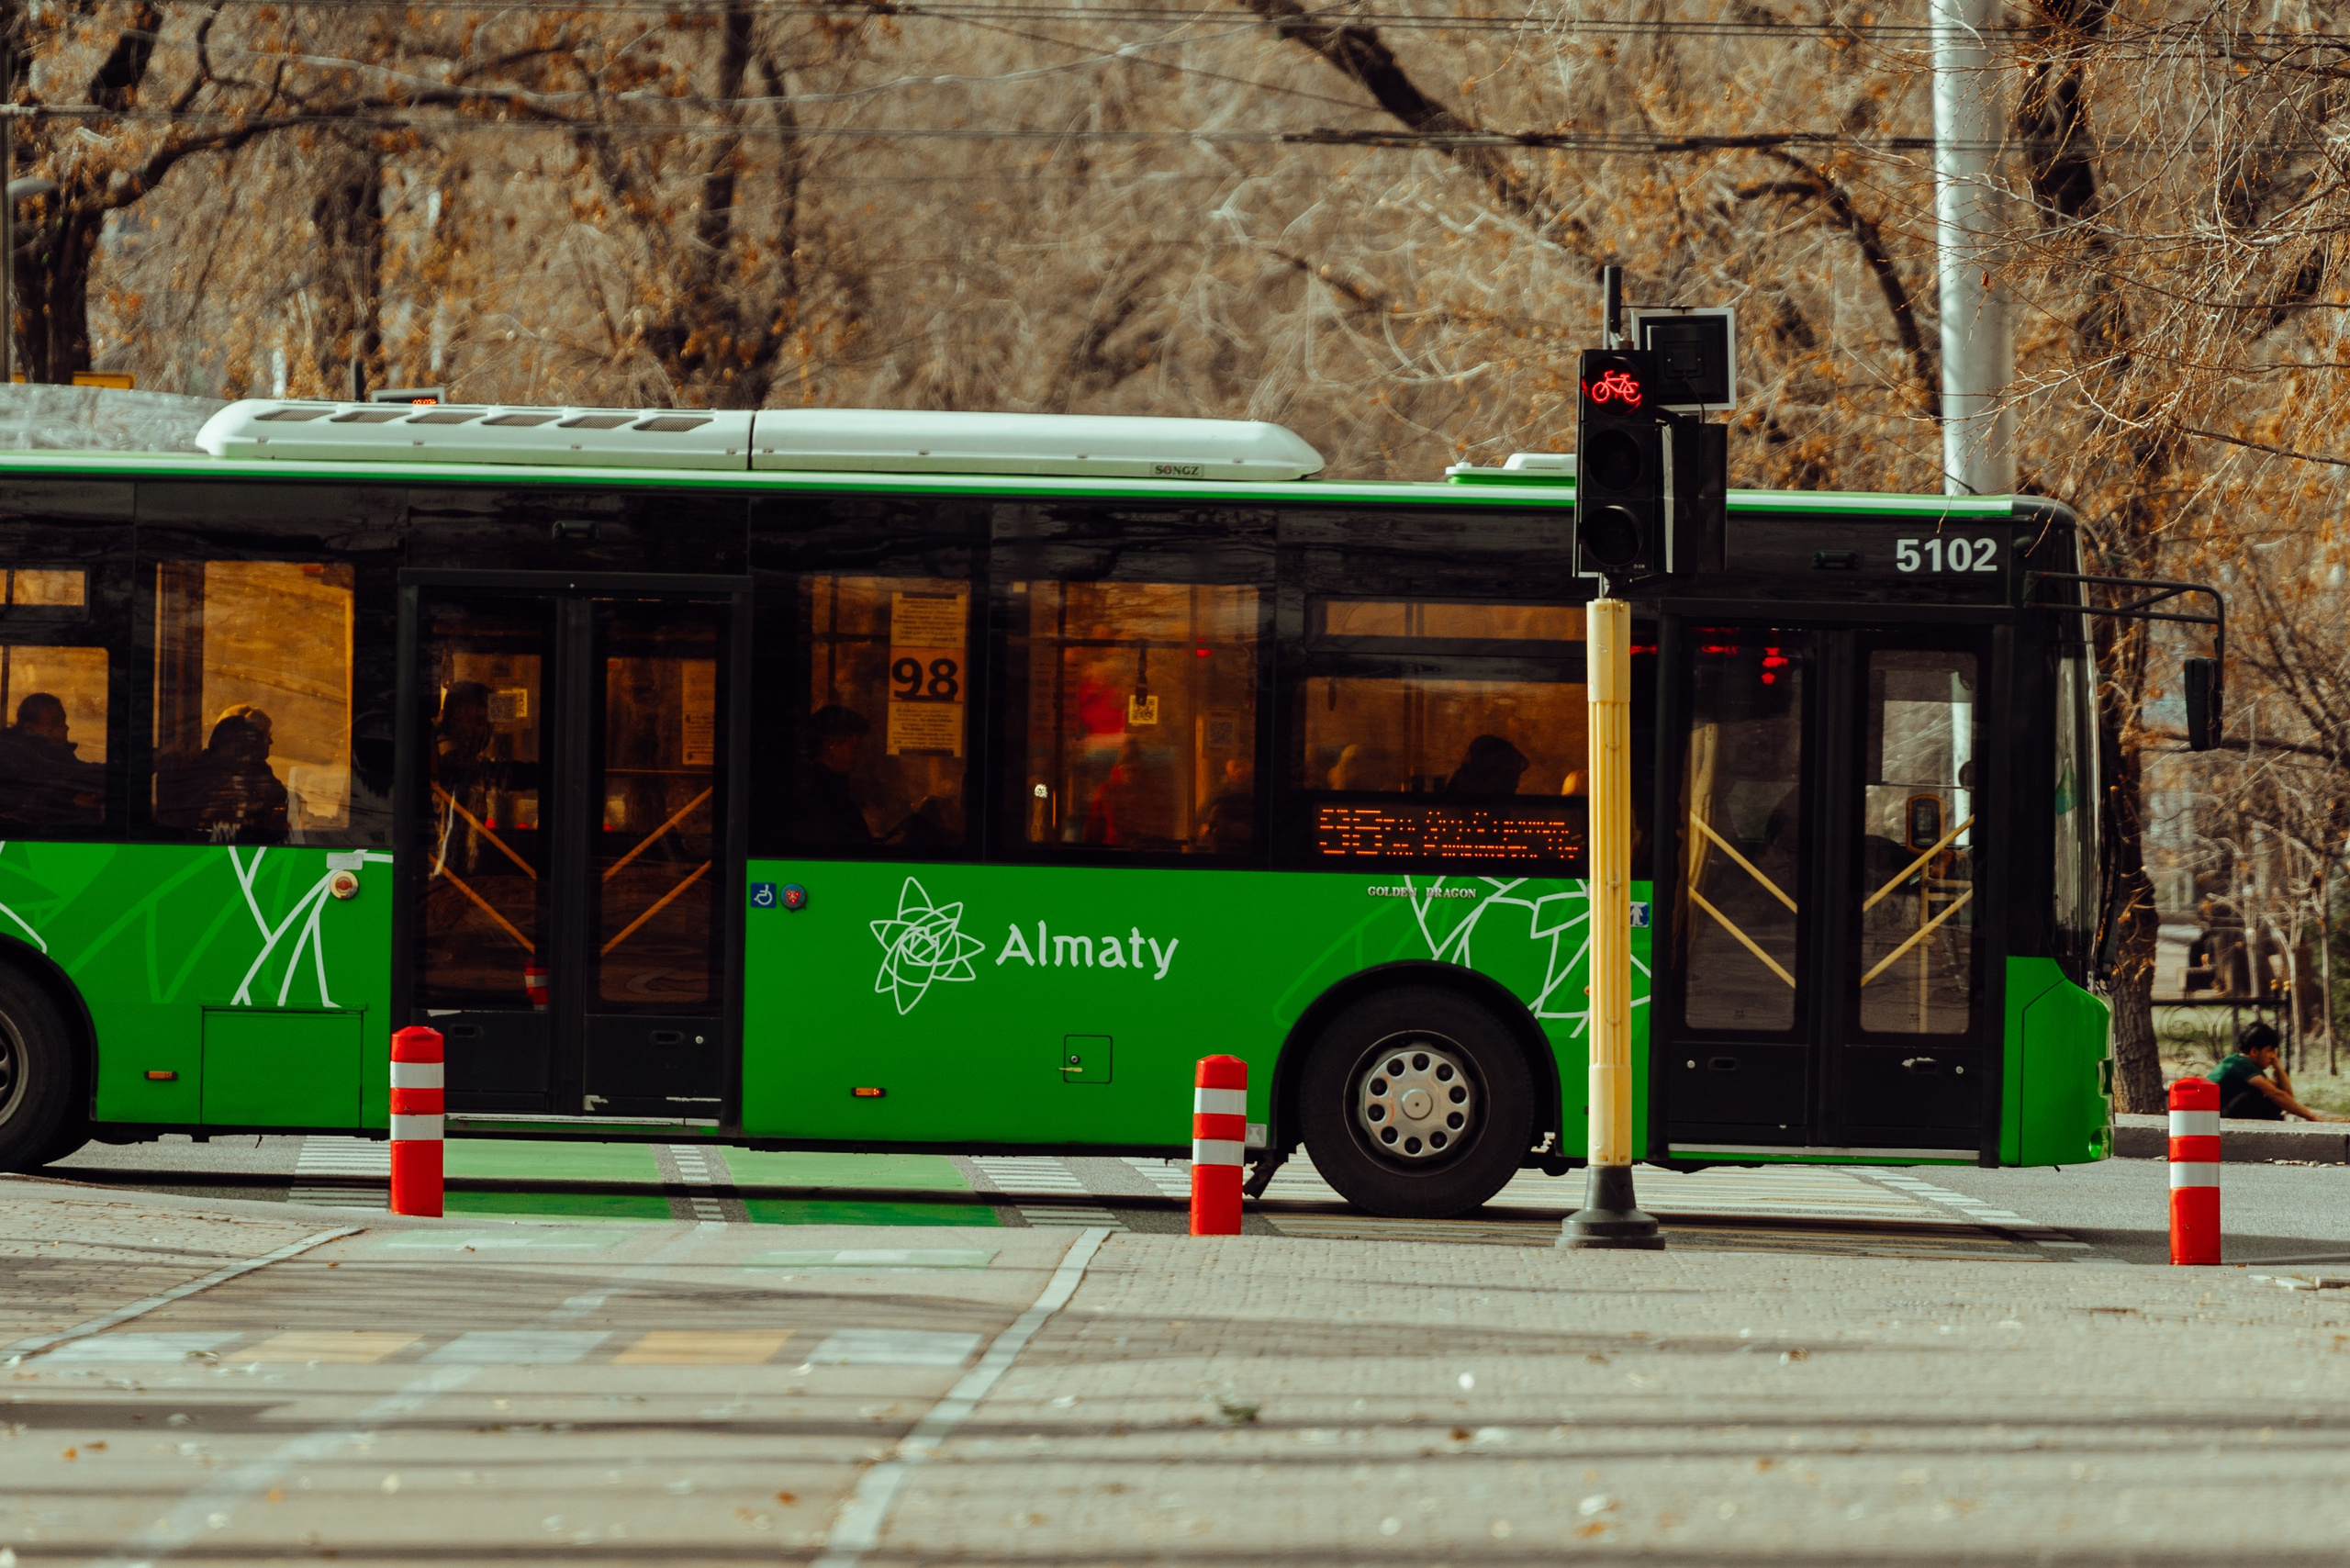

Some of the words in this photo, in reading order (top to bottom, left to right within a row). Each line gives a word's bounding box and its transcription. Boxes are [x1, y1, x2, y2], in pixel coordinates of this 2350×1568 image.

[1154, 465, 1200, 476] SONGZ
[1896, 537, 1998, 572] 5102
[891, 656, 958, 699] 98
[1367, 886, 1417, 898] GOLDEN
[1426, 887, 1477, 899] DRAGON
[995, 919, 1180, 980] Almaty
